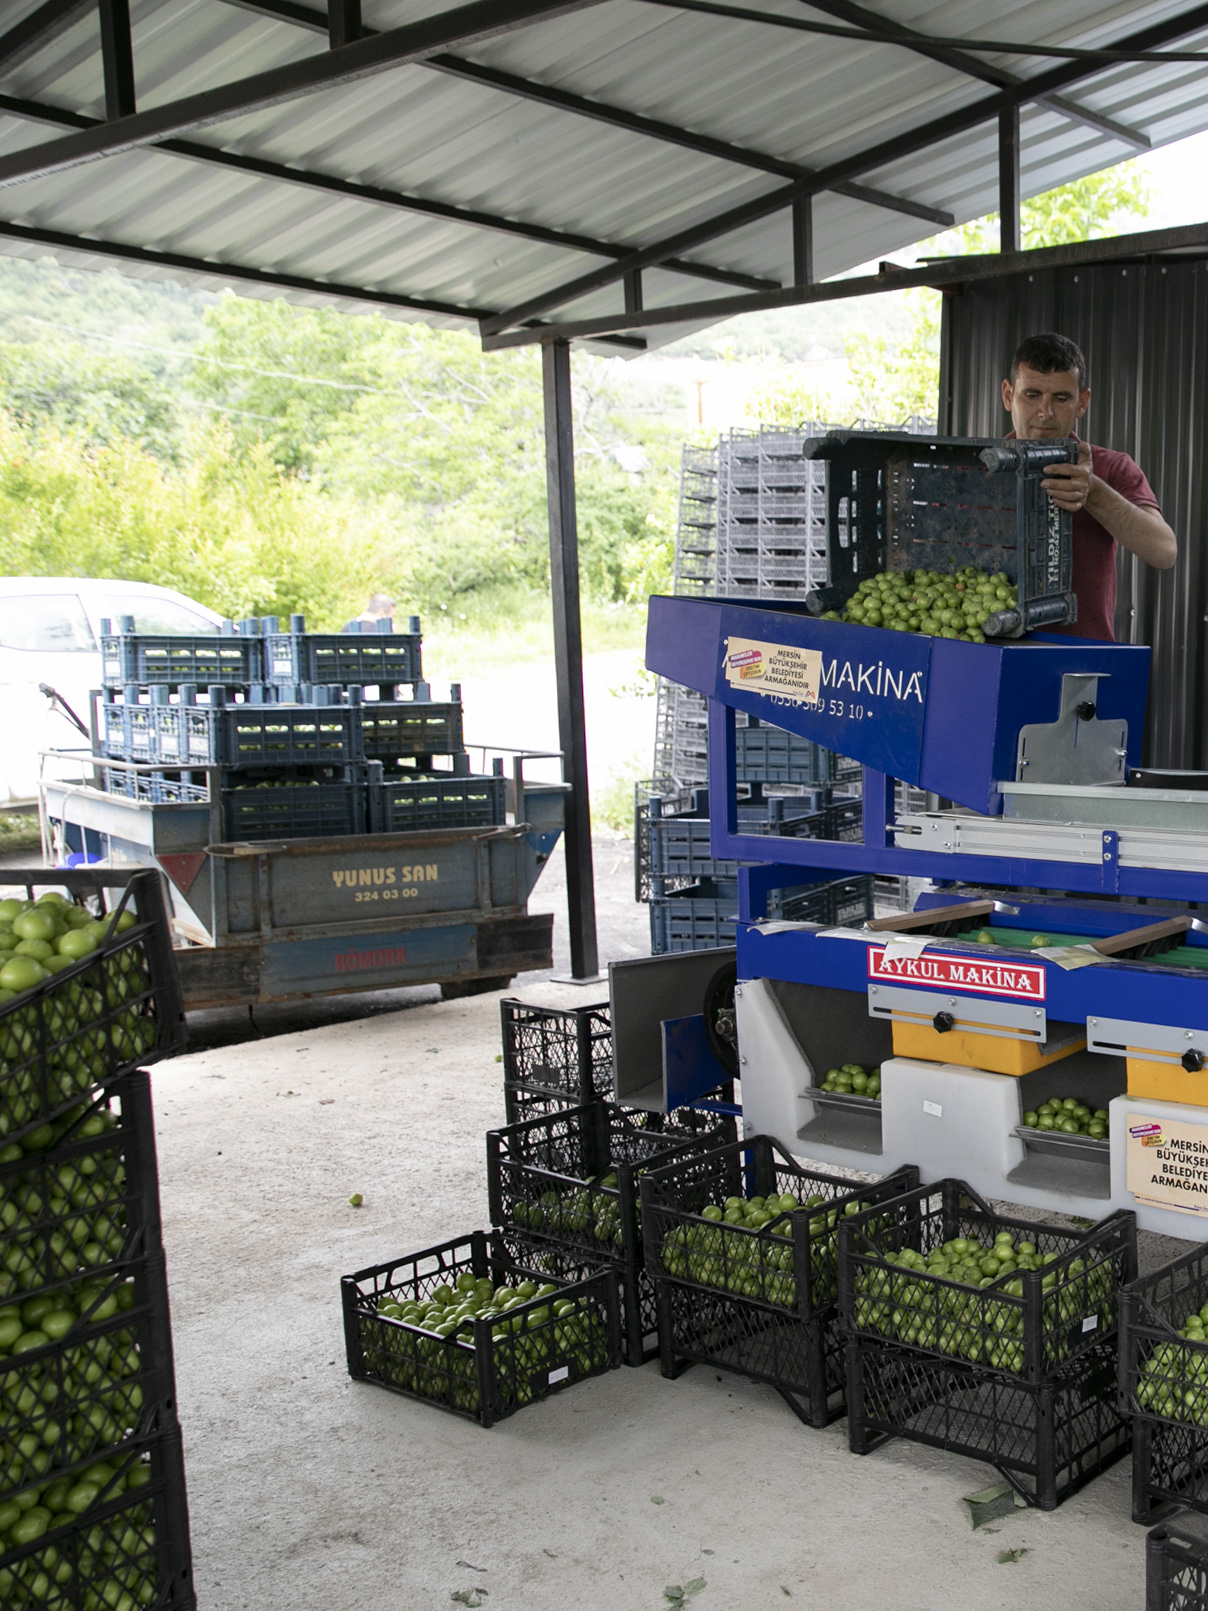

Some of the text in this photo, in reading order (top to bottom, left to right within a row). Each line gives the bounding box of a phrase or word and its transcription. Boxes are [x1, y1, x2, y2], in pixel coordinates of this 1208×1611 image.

[768, 656, 808, 671] BÜYÜKŞEHİR
[777, 650, 801, 660] MERSİN
[771, 667, 804, 680] BELEDİYESİ
[821, 659, 923, 704] MAKİNA
[764, 676, 809, 690] ARMAĞANIDIR
[829, 699, 844, 717] 53
[848, 703, 864, 720] 10
[332, 864, 439, 888] YUNUS SAN
[354, 887, 419, 902] 324 03 00
[334, 946, 408, 973] RÖMORK
[878, 957, 1033, 991] AYKUL MAKİNA
